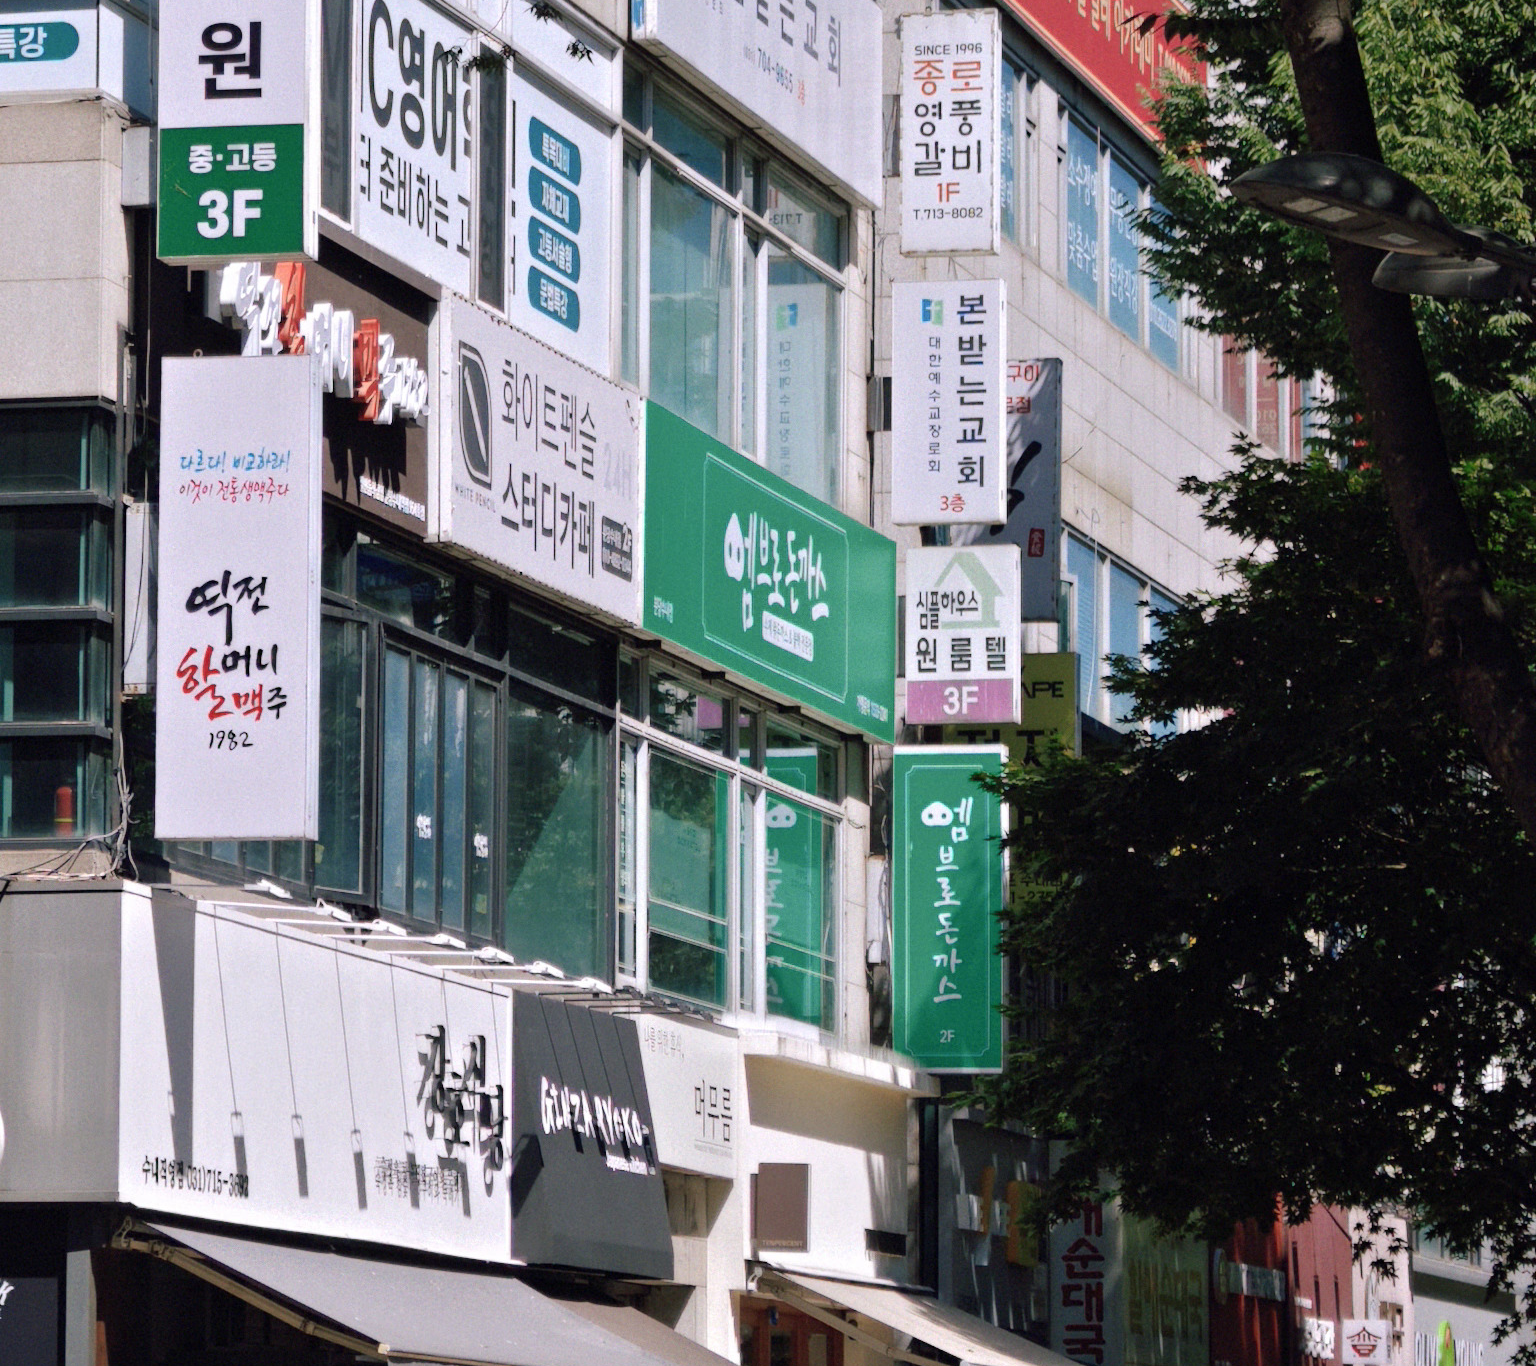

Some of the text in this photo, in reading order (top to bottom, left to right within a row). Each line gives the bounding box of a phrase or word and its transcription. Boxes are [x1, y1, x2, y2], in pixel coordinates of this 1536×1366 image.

[914, 42, 983, 56] SINCE 1996
[913, 59, 983, 96] 종로
[914, 99, 982, 136] 영풍
[914, 139, 982, 177] 갈비
[936, 182, 960, 203] 1F
[196, 188, 264, 239] 3F
[913, 207, 984, 221] T.713-8082
[955, 294, 988, 488] 본받는교회
[179, 446, 291, 473] 다르다! 비교하라!
[179, 478, 213, 504] 이것이
[939, 493, 966, 513] 3층
[500, 463, 595, 579] 스터디카페
[185, 570, 270, 645] 역전
[915, 590, 979, 631] 심플하우스
[915, 636, 1007, 673] 원룸텔
[175, 643, 280, 721] 할머니
[231, 684, 287, 721] 맥주
[942, 686, 980, 716] 3F
[208, 730, 254, 750] 1982
[939, 1029, 956, 1044] 2F
[540, 1074, 596, 1139] GINZA
[694, 1079, 734, 1143] 머무름
